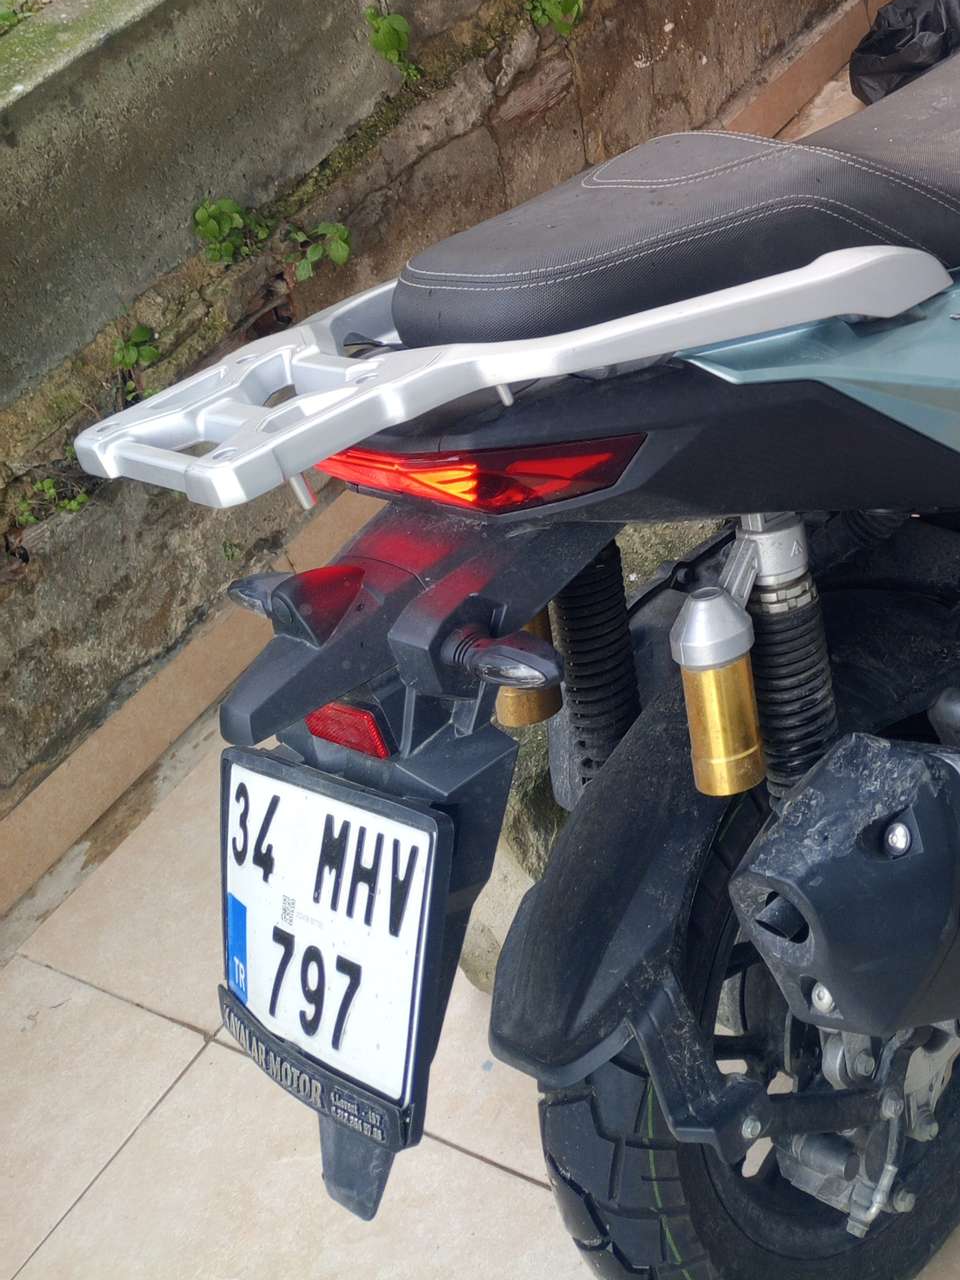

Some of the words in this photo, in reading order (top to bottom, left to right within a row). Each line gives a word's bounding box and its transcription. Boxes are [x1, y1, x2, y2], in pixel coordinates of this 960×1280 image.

[232, 782, 280, 883] 34
[313, 813, 419, 938] MHV
[232, 955, 246, 991] TR
[269, 925, 362, 1051] 797
[223, 1004, 267, 1070] KAYALAR
[269, 1050, 323, 1108] MOTOR
